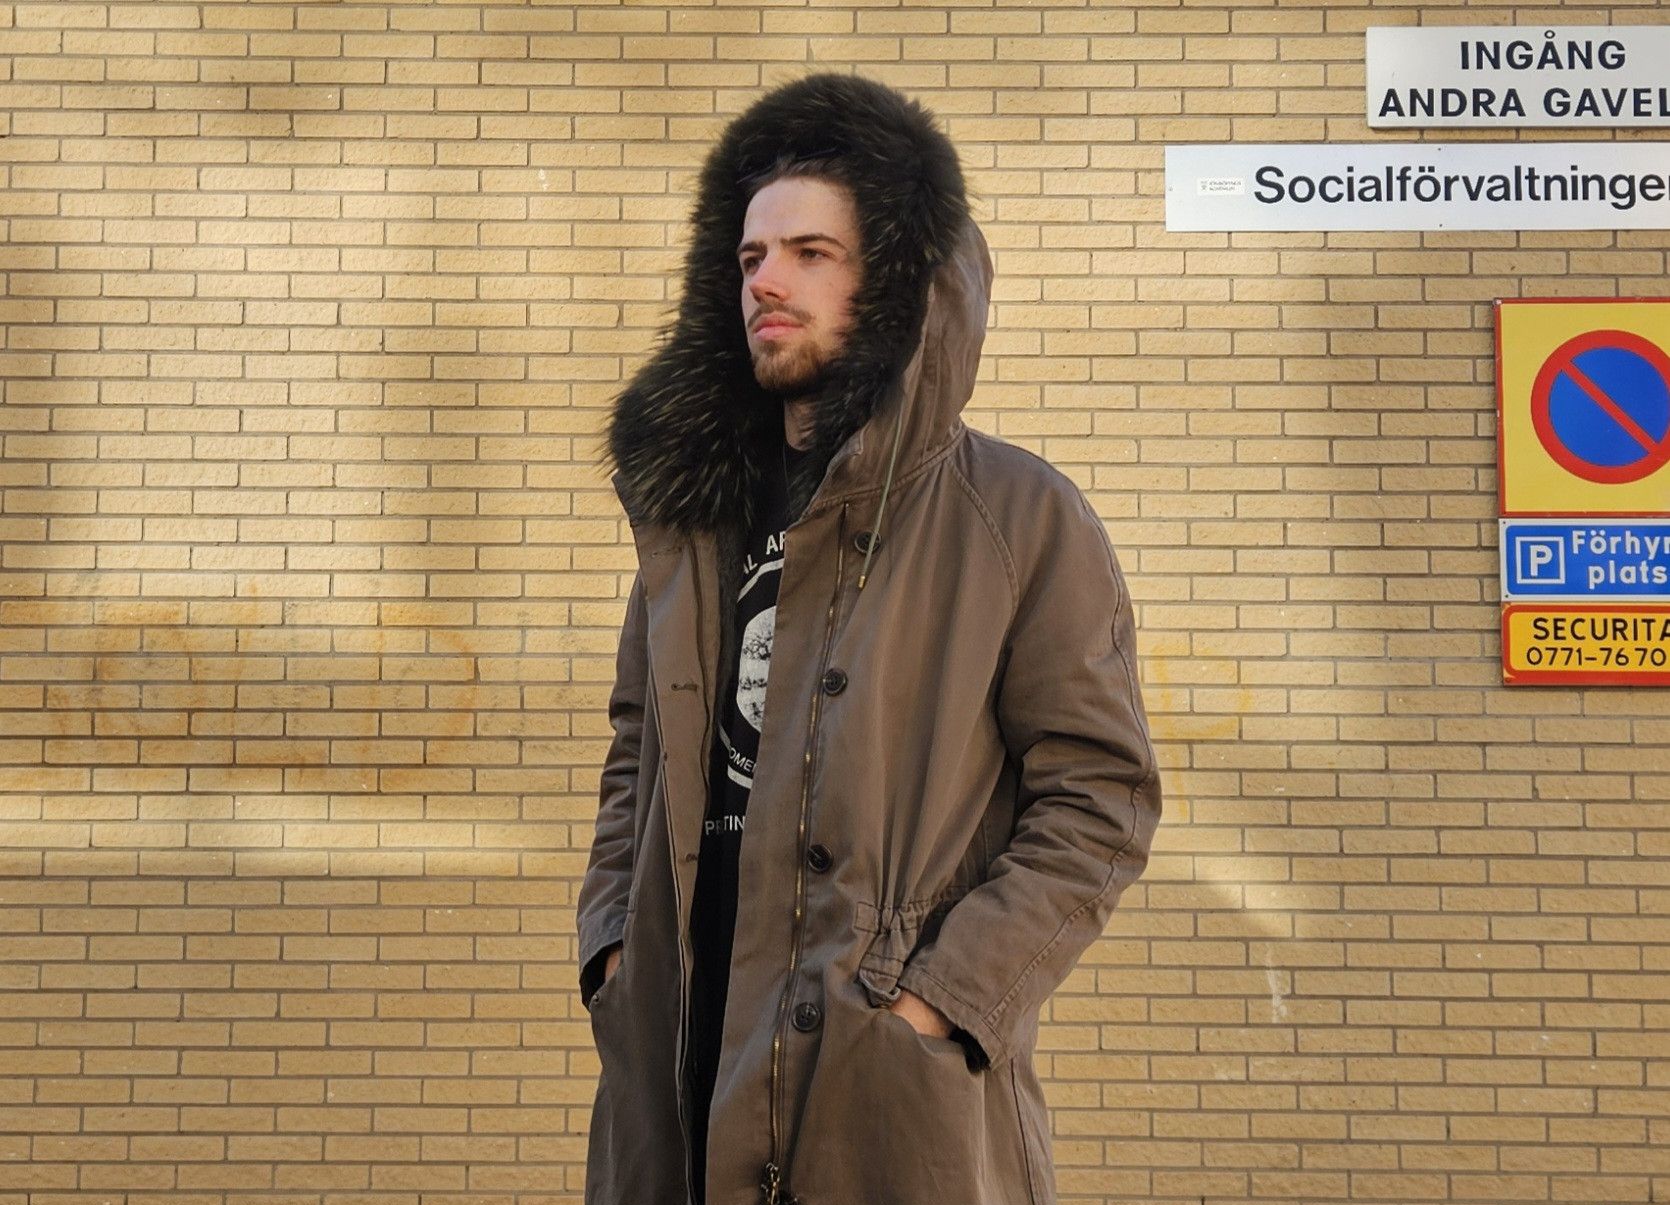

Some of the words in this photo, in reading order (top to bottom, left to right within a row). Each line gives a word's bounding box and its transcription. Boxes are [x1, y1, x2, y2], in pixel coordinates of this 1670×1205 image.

[1460, 30, 1626, 70] INGÅNG
[1378, 88, 1527, 118] ANDRA
[1254, 164, 1670, 211] Socialförvaltninge
[1530, 544, 1553, 576] P
[1588, 559, 1668, 590] plats
